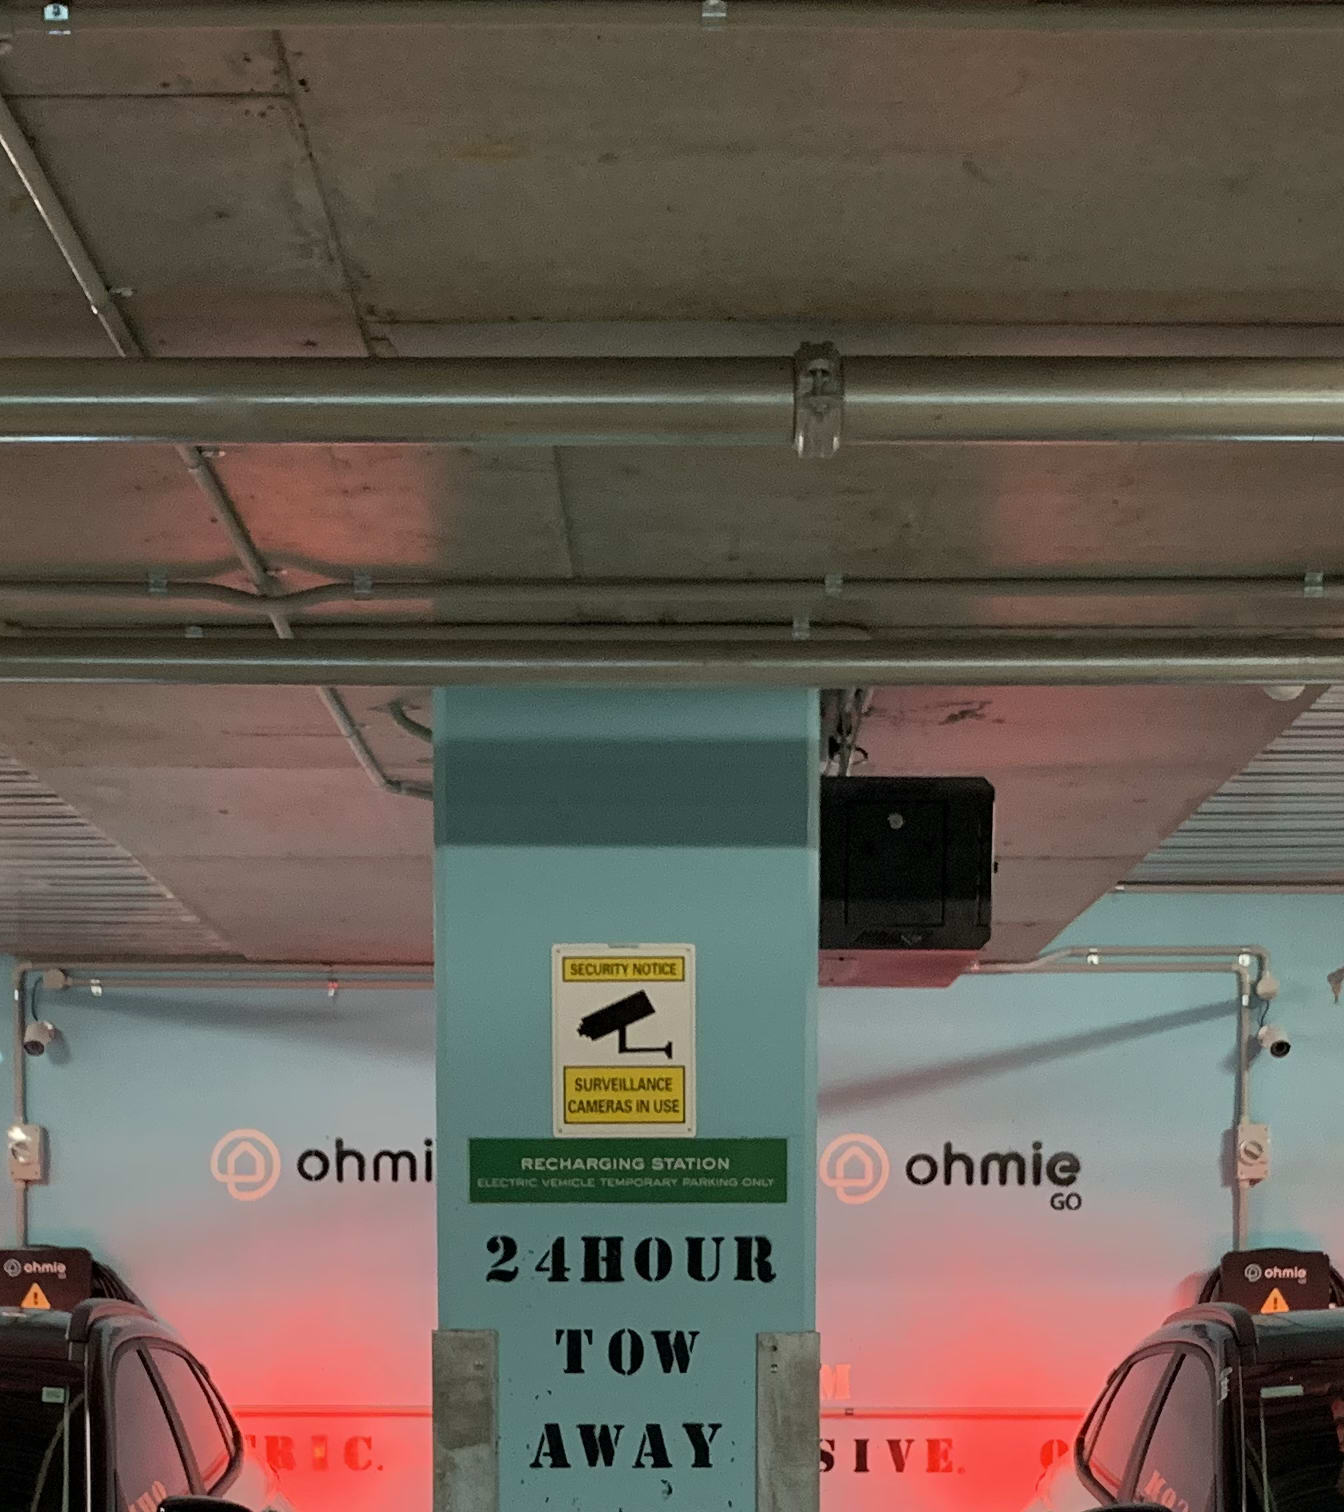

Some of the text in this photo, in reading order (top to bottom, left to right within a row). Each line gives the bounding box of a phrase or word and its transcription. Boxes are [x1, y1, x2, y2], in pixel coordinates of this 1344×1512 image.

[570, 963, 677, 976] SECURITY NOTICE
[574, 1077, 672, 1092] SURVEILLANCE
[567, 1100, 680, 1114] CAMERAS IN USE
[521, 1157, 730, 1171] RECHARGING STATION
[905, 1141, 1082, 1187] ohmie
[477, 1177, 774, 1188] ELECTRIC VEHICLE TEMPORARY PARKING ONLY
[1050, 1192, 1082, 1211] GO
[555, 1328, 700, 1376] TOW
[245, 1434, 384, 1472] RIC.
[529, 1423, 723, 1469] AWAY
